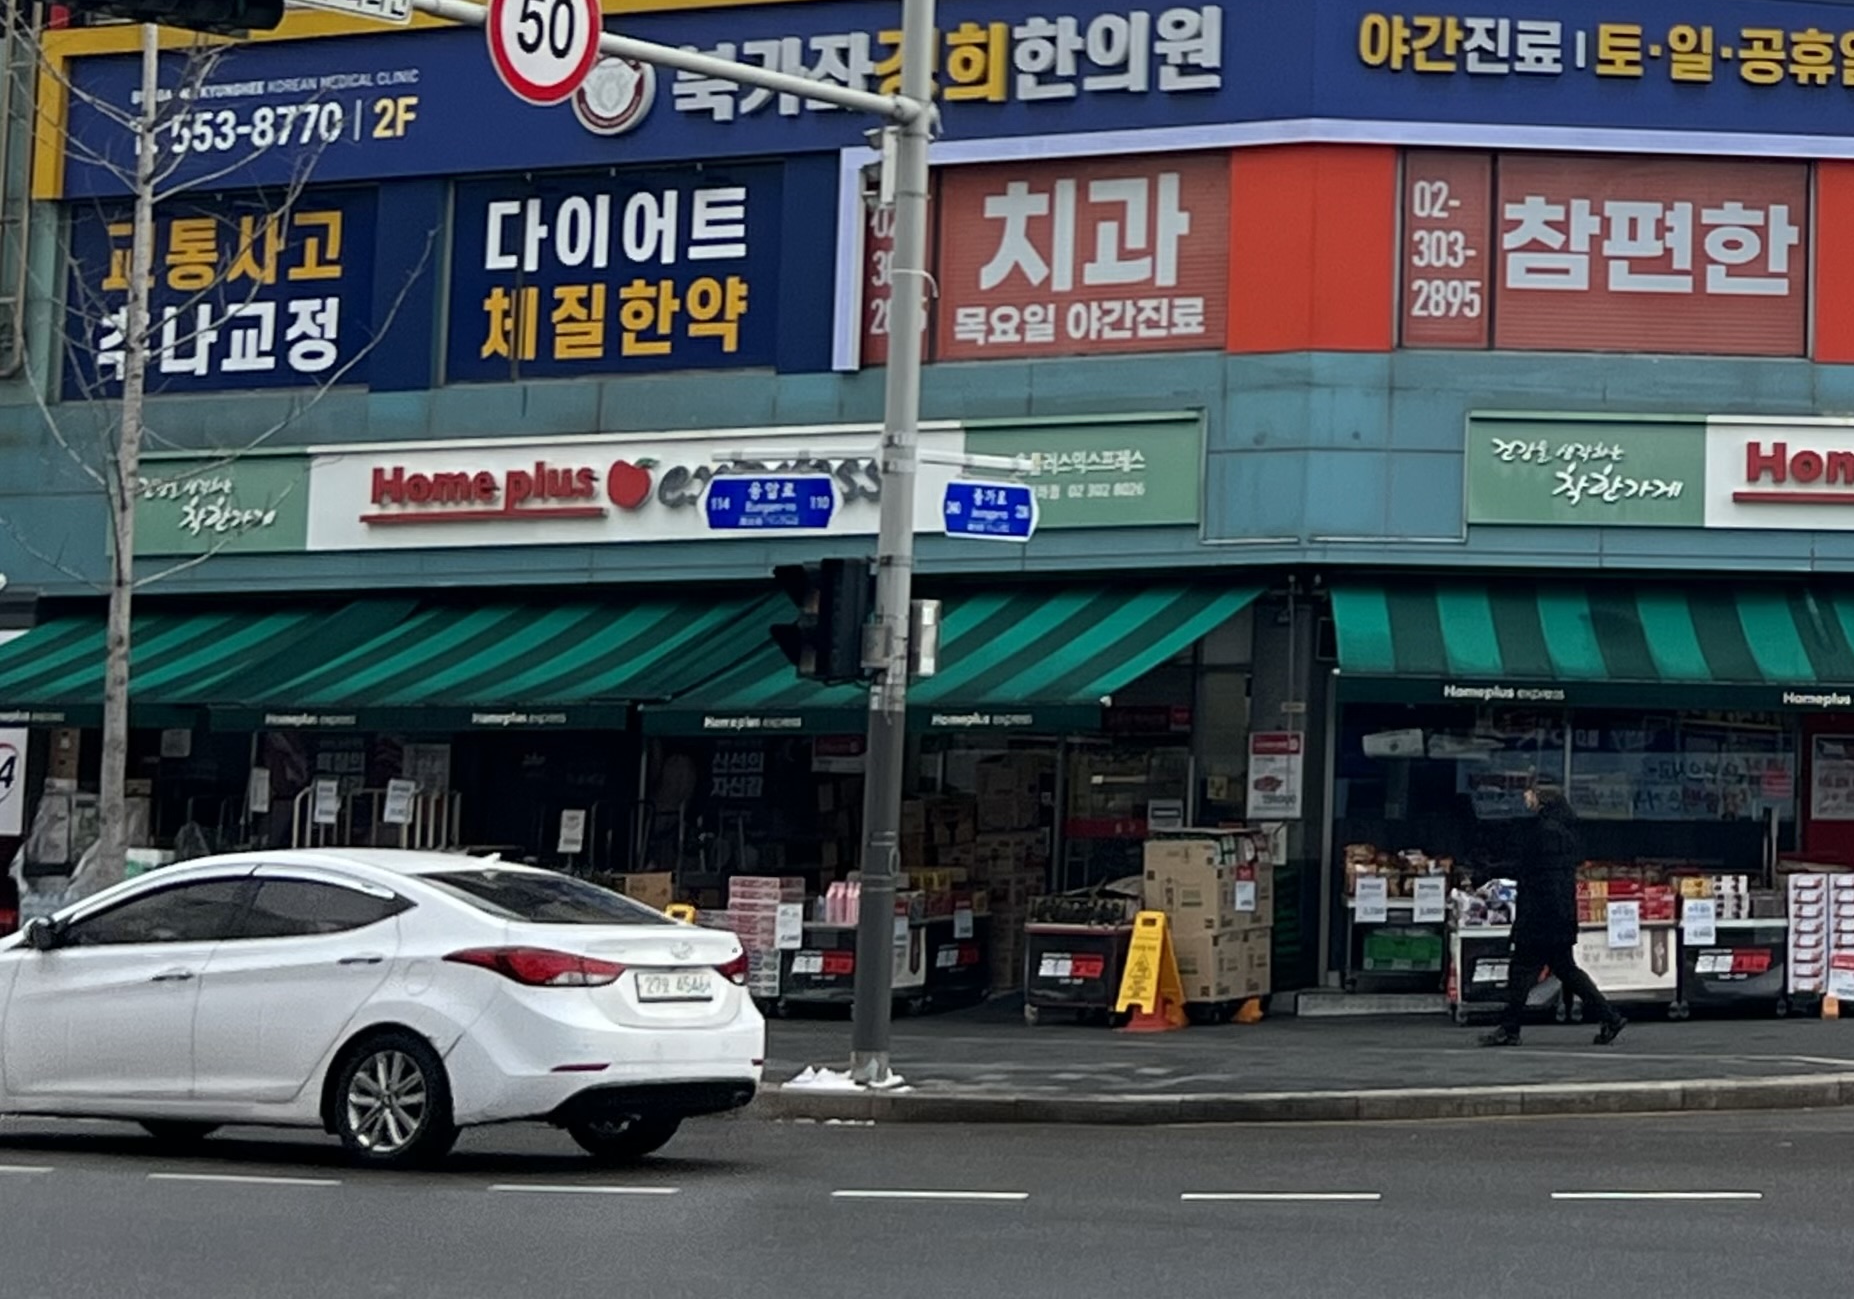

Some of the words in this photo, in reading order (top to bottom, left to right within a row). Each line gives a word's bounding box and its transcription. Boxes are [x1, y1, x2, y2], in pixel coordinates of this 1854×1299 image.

[1358, 13, 1563, 76] 야간진료
[268, 77, 317, 94] KOREAN
[320, 72, 374, 90] MEDICAL
[377, 68, 420, 86] CLINIC
[372, 97, 419, 139] 2F
[1412, 180, 1460, 219] 02-
[101, 210, 343, 292] 교통사고
[485, 187, 747, 273] 다이어트
[980, 172, 1190, 293] 치과
[1412, 230, 1476, 269] 303-
[1503, 196, 1799, 296] 참편한
[481, 276, 748, 364] 체질한약
[954, 304, 1055, 345] 목요일
[1066, 296, 1205, 340] 야간진료
[1411, 280, 1482, 319] 2895
[371, 466, 496, 505] Home
[504, 461, 598, 515] plus
[1551, 461, 1685, 506] 착한가게
[1782, 691, 1852, 709] Homeplus
